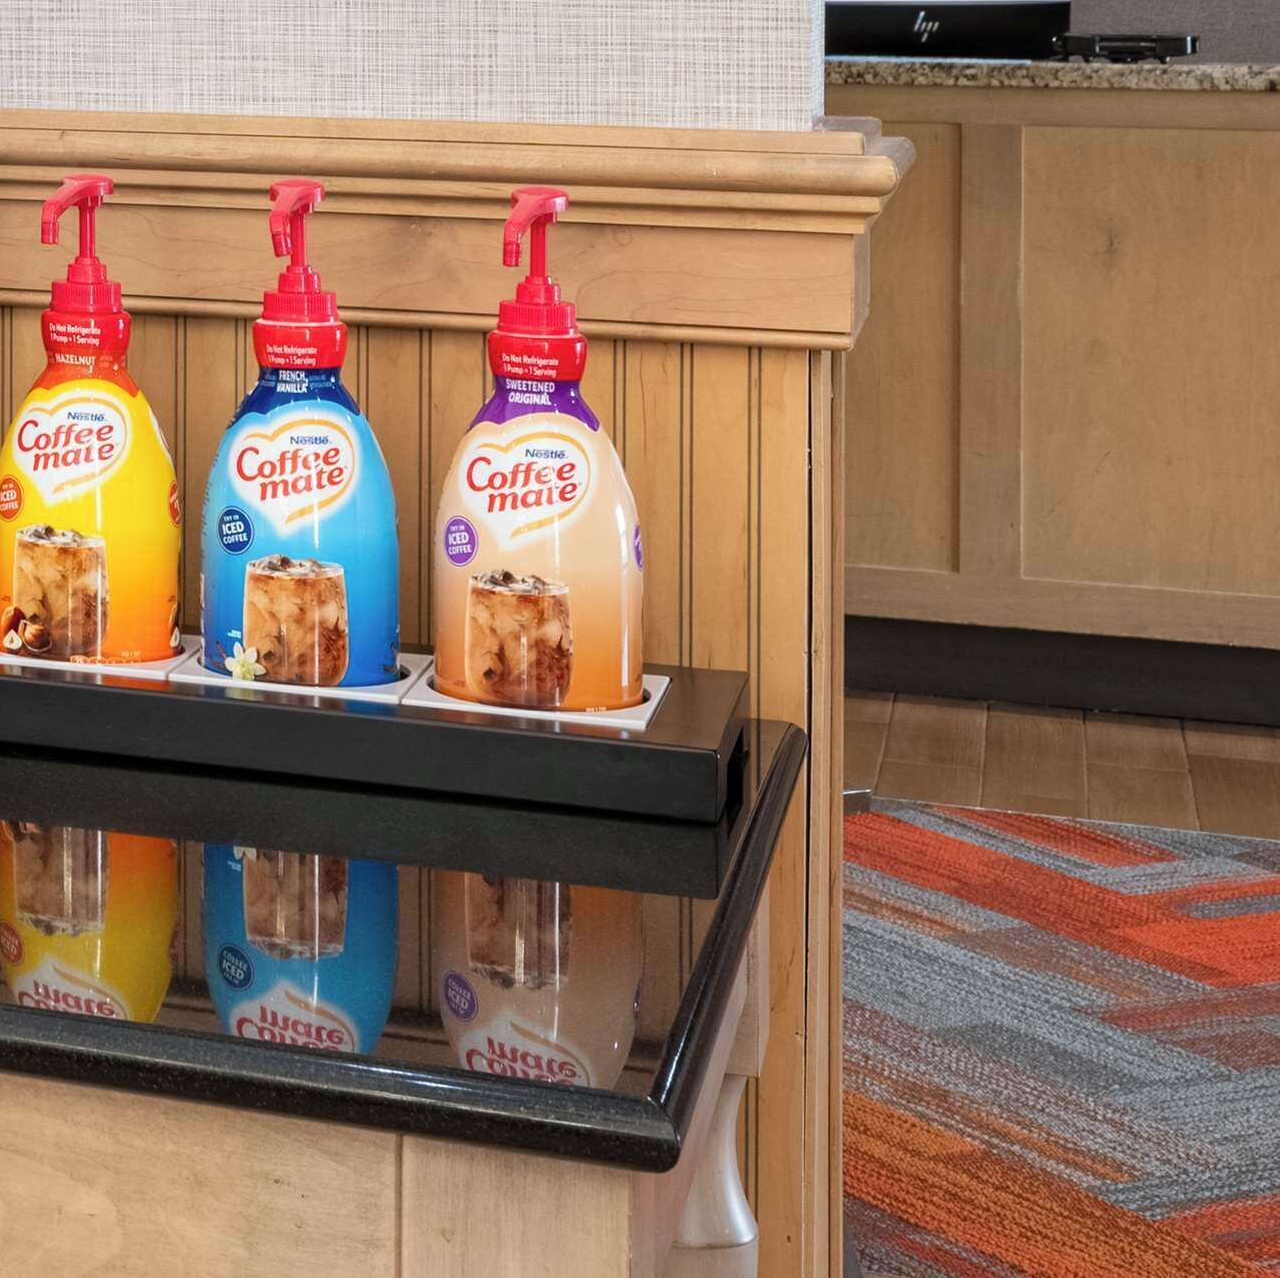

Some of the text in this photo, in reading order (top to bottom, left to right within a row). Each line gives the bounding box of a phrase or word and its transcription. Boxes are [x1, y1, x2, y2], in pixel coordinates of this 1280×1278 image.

[913, 11, 940, 42] hp
[49, 322, 56, 331] Do
[56, 323, 67, 332] Not
[76, 335, 100, 346] Serving
[284, 345, 317, 356] Refrigerate
[55, 353, 96, 366] HAZELNUT
[293, 356, 316, 366] Serving
[502, 353, 559, 366] Do Not Refrigerate
[279, 370, 305, 381] FRENCH
[507, 365, 523, 375] Pump
[533, 367, 556, 378] Serving
[276, 382, 307, 393] VANILLA
[506, 379, 555, 393] SWEETENED
[508, 392, 552, 406] ORIGINAL
[17, 420, 114, 453] Coffee
[32, 443, 114, 471] mate
[236, 447, 340, 482] Coffee
[466, 456, 576, 492] Coffee
[259, 466, 345, 501] mate
[0, 490, 17, 502] ICED
[487, 482, 578, 513] mate
[0, 502, 18, 512] COFFEE
[222, 521, 244, 535] ICED
[223, 533, 248, 545] COFFEE
[448, 532, 469, 545] ICED
[448, 544, 472, 555] COFFEE
